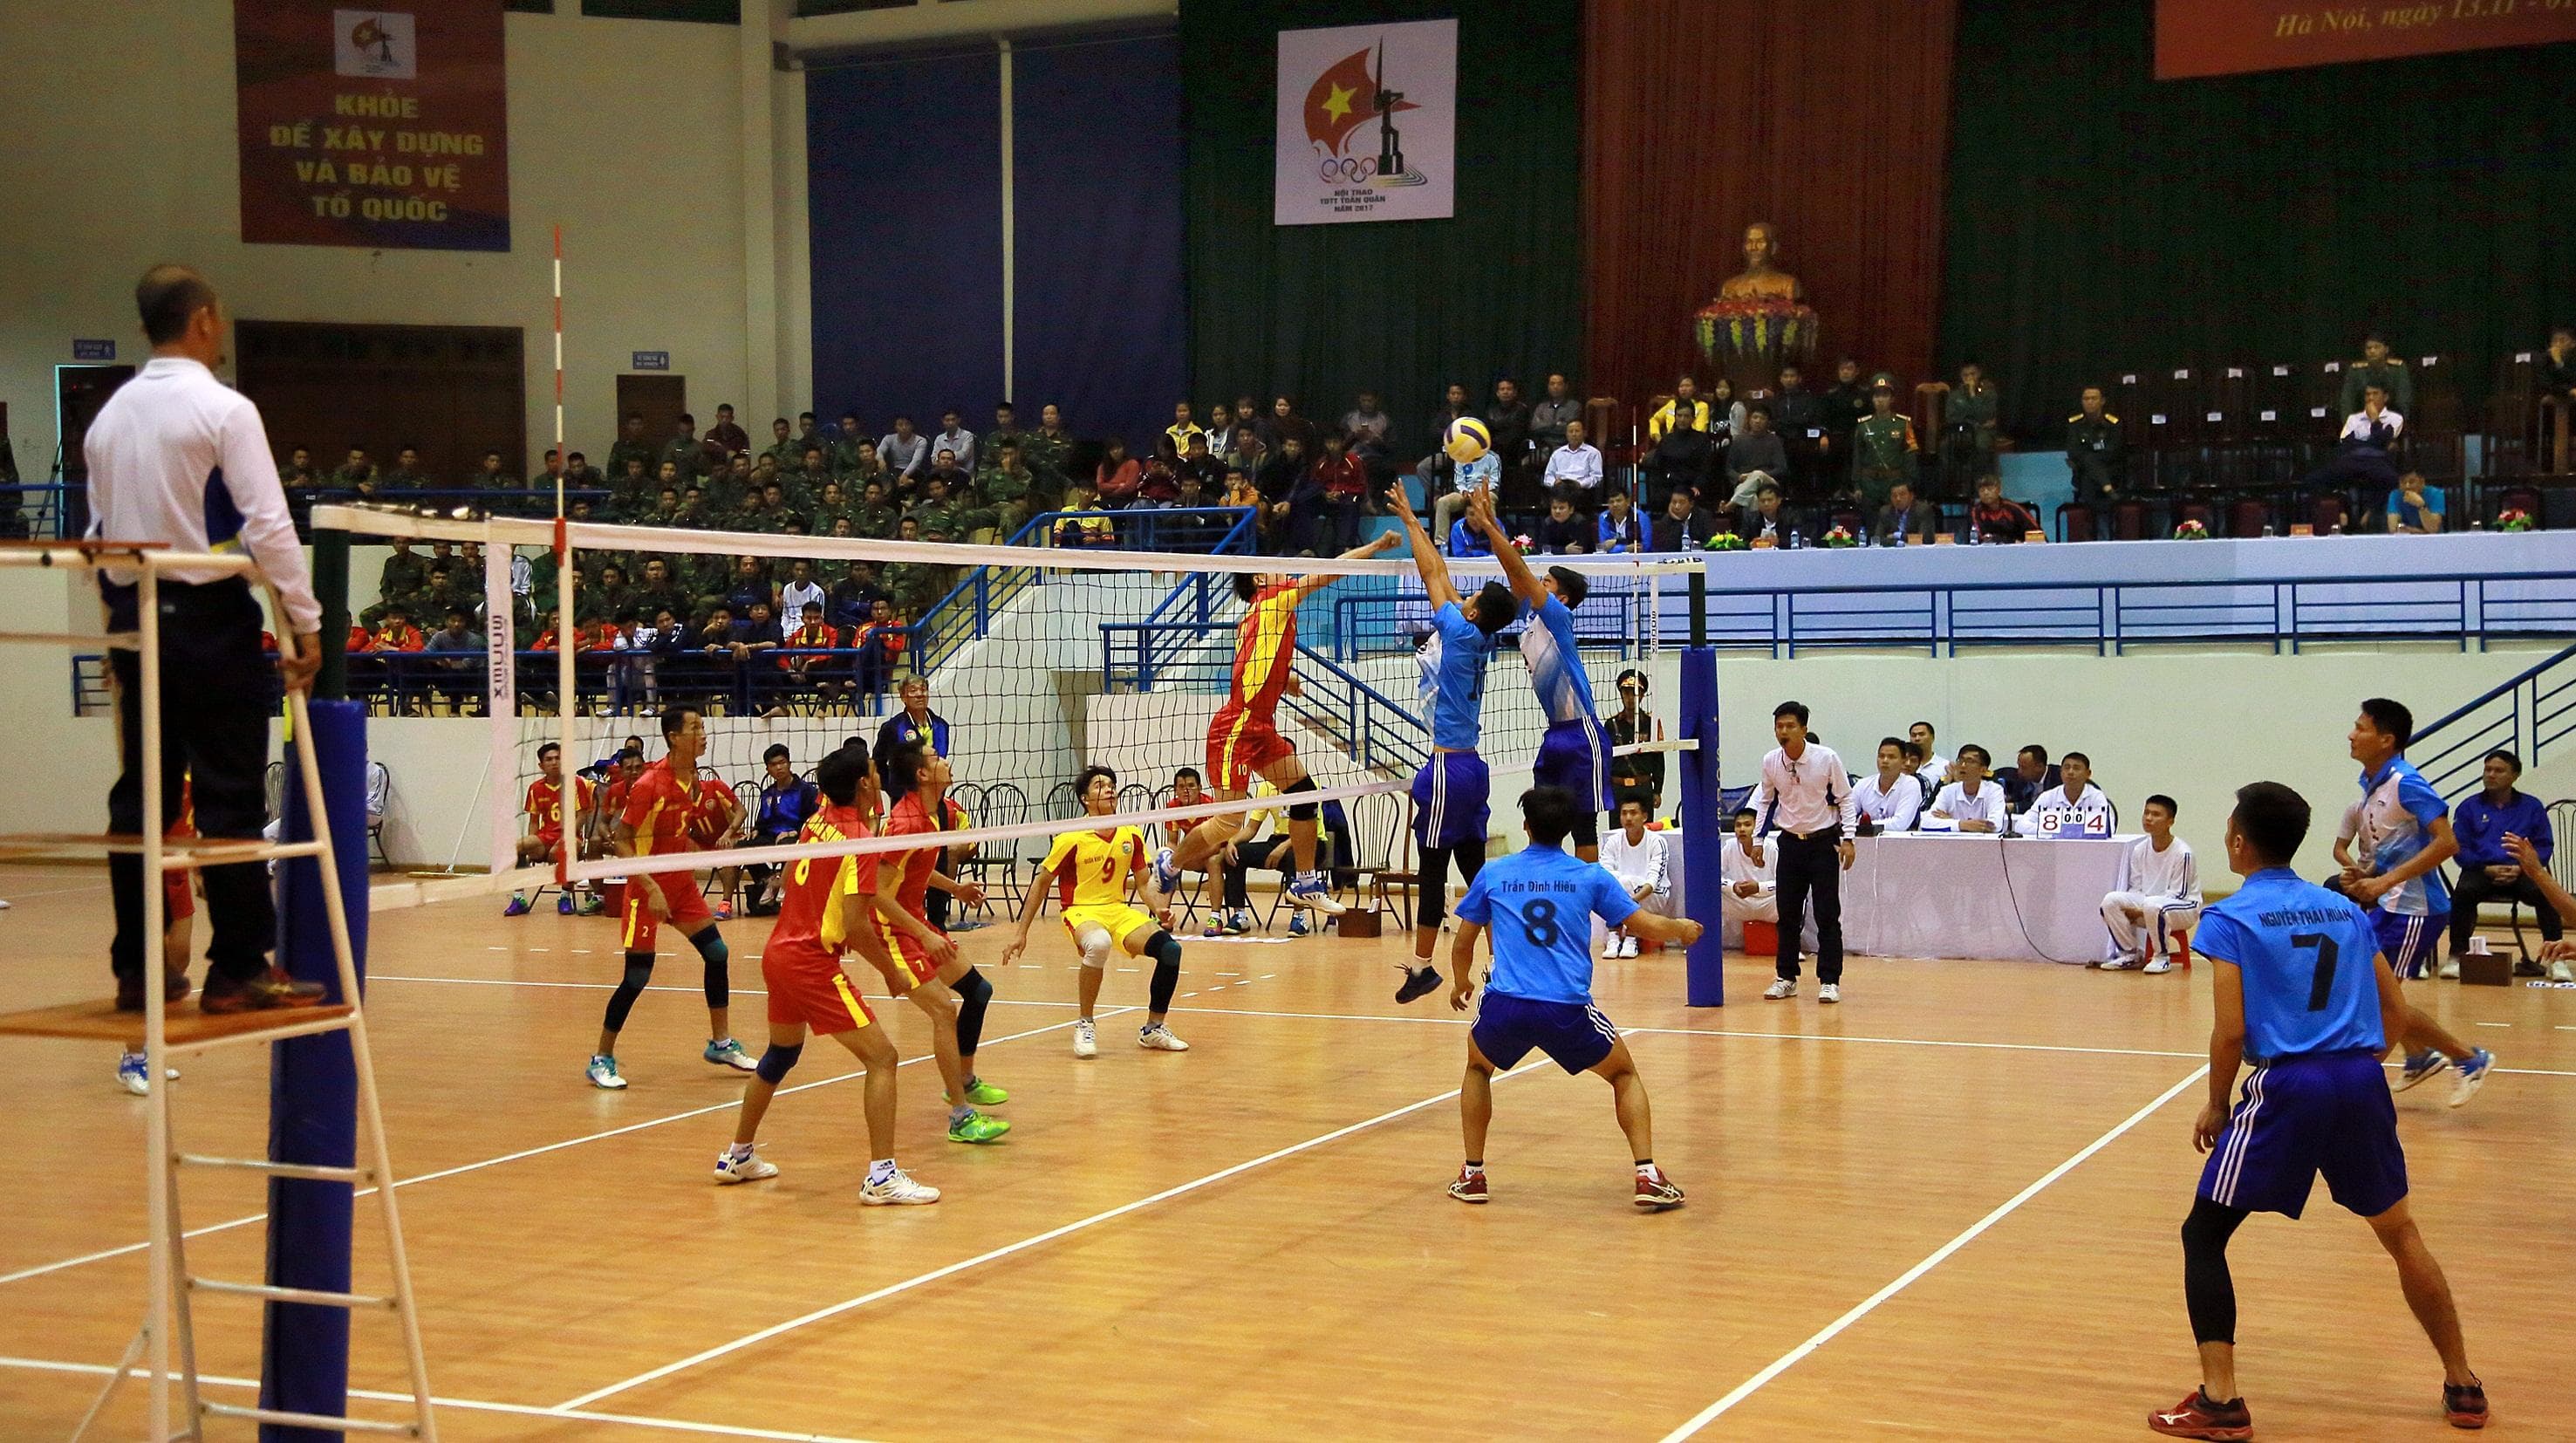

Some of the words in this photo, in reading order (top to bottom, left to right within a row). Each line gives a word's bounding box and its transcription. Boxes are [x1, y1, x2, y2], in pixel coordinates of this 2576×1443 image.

[2274, 13, 2312, 37] Hà
[2320, 7, 2373, 32] Nội,
[335, 87, 420, 119] KHỎE
[270, 120, 312, 149] ĐỂ
[323, 124, 385, 151] XÂY
[397, 131, 484, 158] DỰNG
[296, 159, 338, 184] VÀ
[348, 155, 413, 188] BẢO
[423, 164, 461, 193] VỆ
[311, 189, 351, 218] TỔ
[362, 192, 448, 222] QUỐC
[1238, 763, 1247, 776] 10
[550, 802, 561, 822] 6
[697, 816, 714, 836] 11
[2043, 814, 2058, 831] 8
[2064, 813, 2072, 823] 0
[2075, 813, 2082, 823] 0
[2087, 814, 2104, 831] 4
[1102, 856, 1116, 885] 9
[1501, 879, 1524, 892] Trần
[1527, 879, 1550, 892] Đình
[1522, 898, 1557, 948] 8
[2258, 906, 2299, 927] NGUYỄN
[2299, 906, 2326, 926] THÁI
[641, 926, 649, 938] 2
[2290, 933, 2340, 1012] 7
